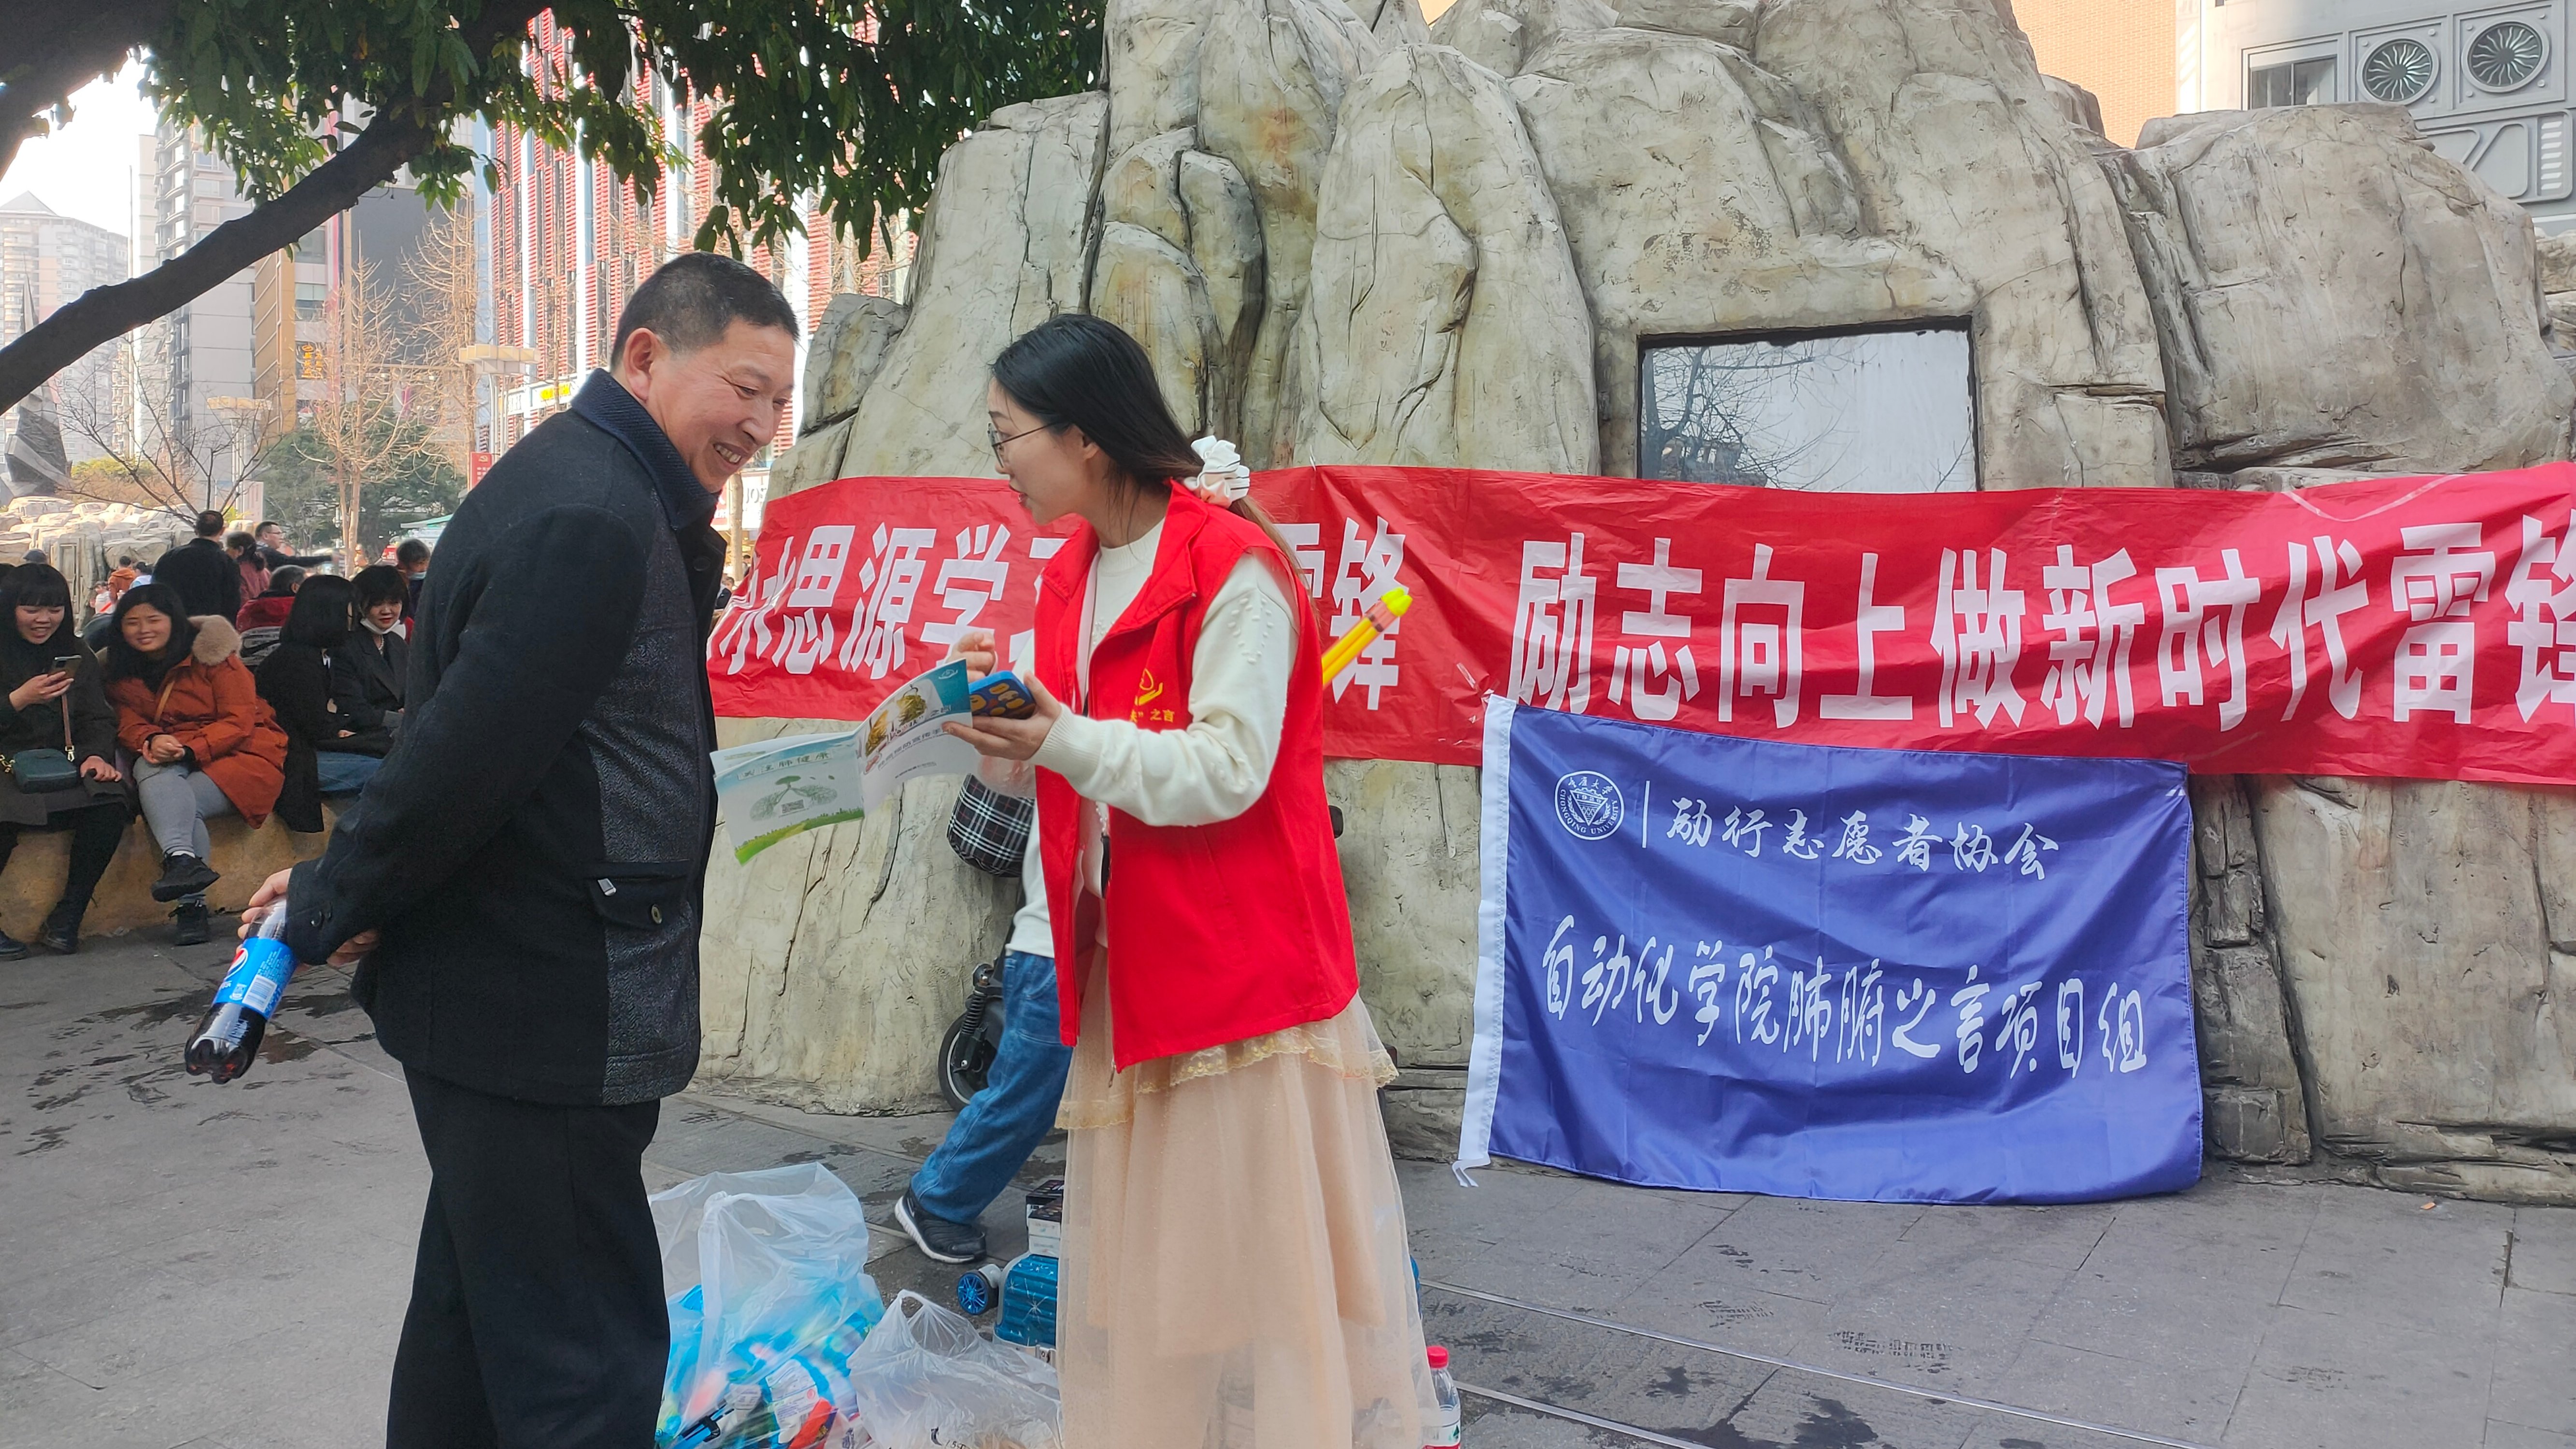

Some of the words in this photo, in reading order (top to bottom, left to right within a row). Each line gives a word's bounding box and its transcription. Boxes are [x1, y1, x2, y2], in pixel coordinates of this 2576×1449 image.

[1560, 789, 1587, 834] CHONGQING
[1590, 799, 1619, 835] UNIVERSITY
[1665, 796, 2059, 880] 励行志愿者协会
[1542, 914, 2148, 1080] 自动化学院肺腑之言项目组
